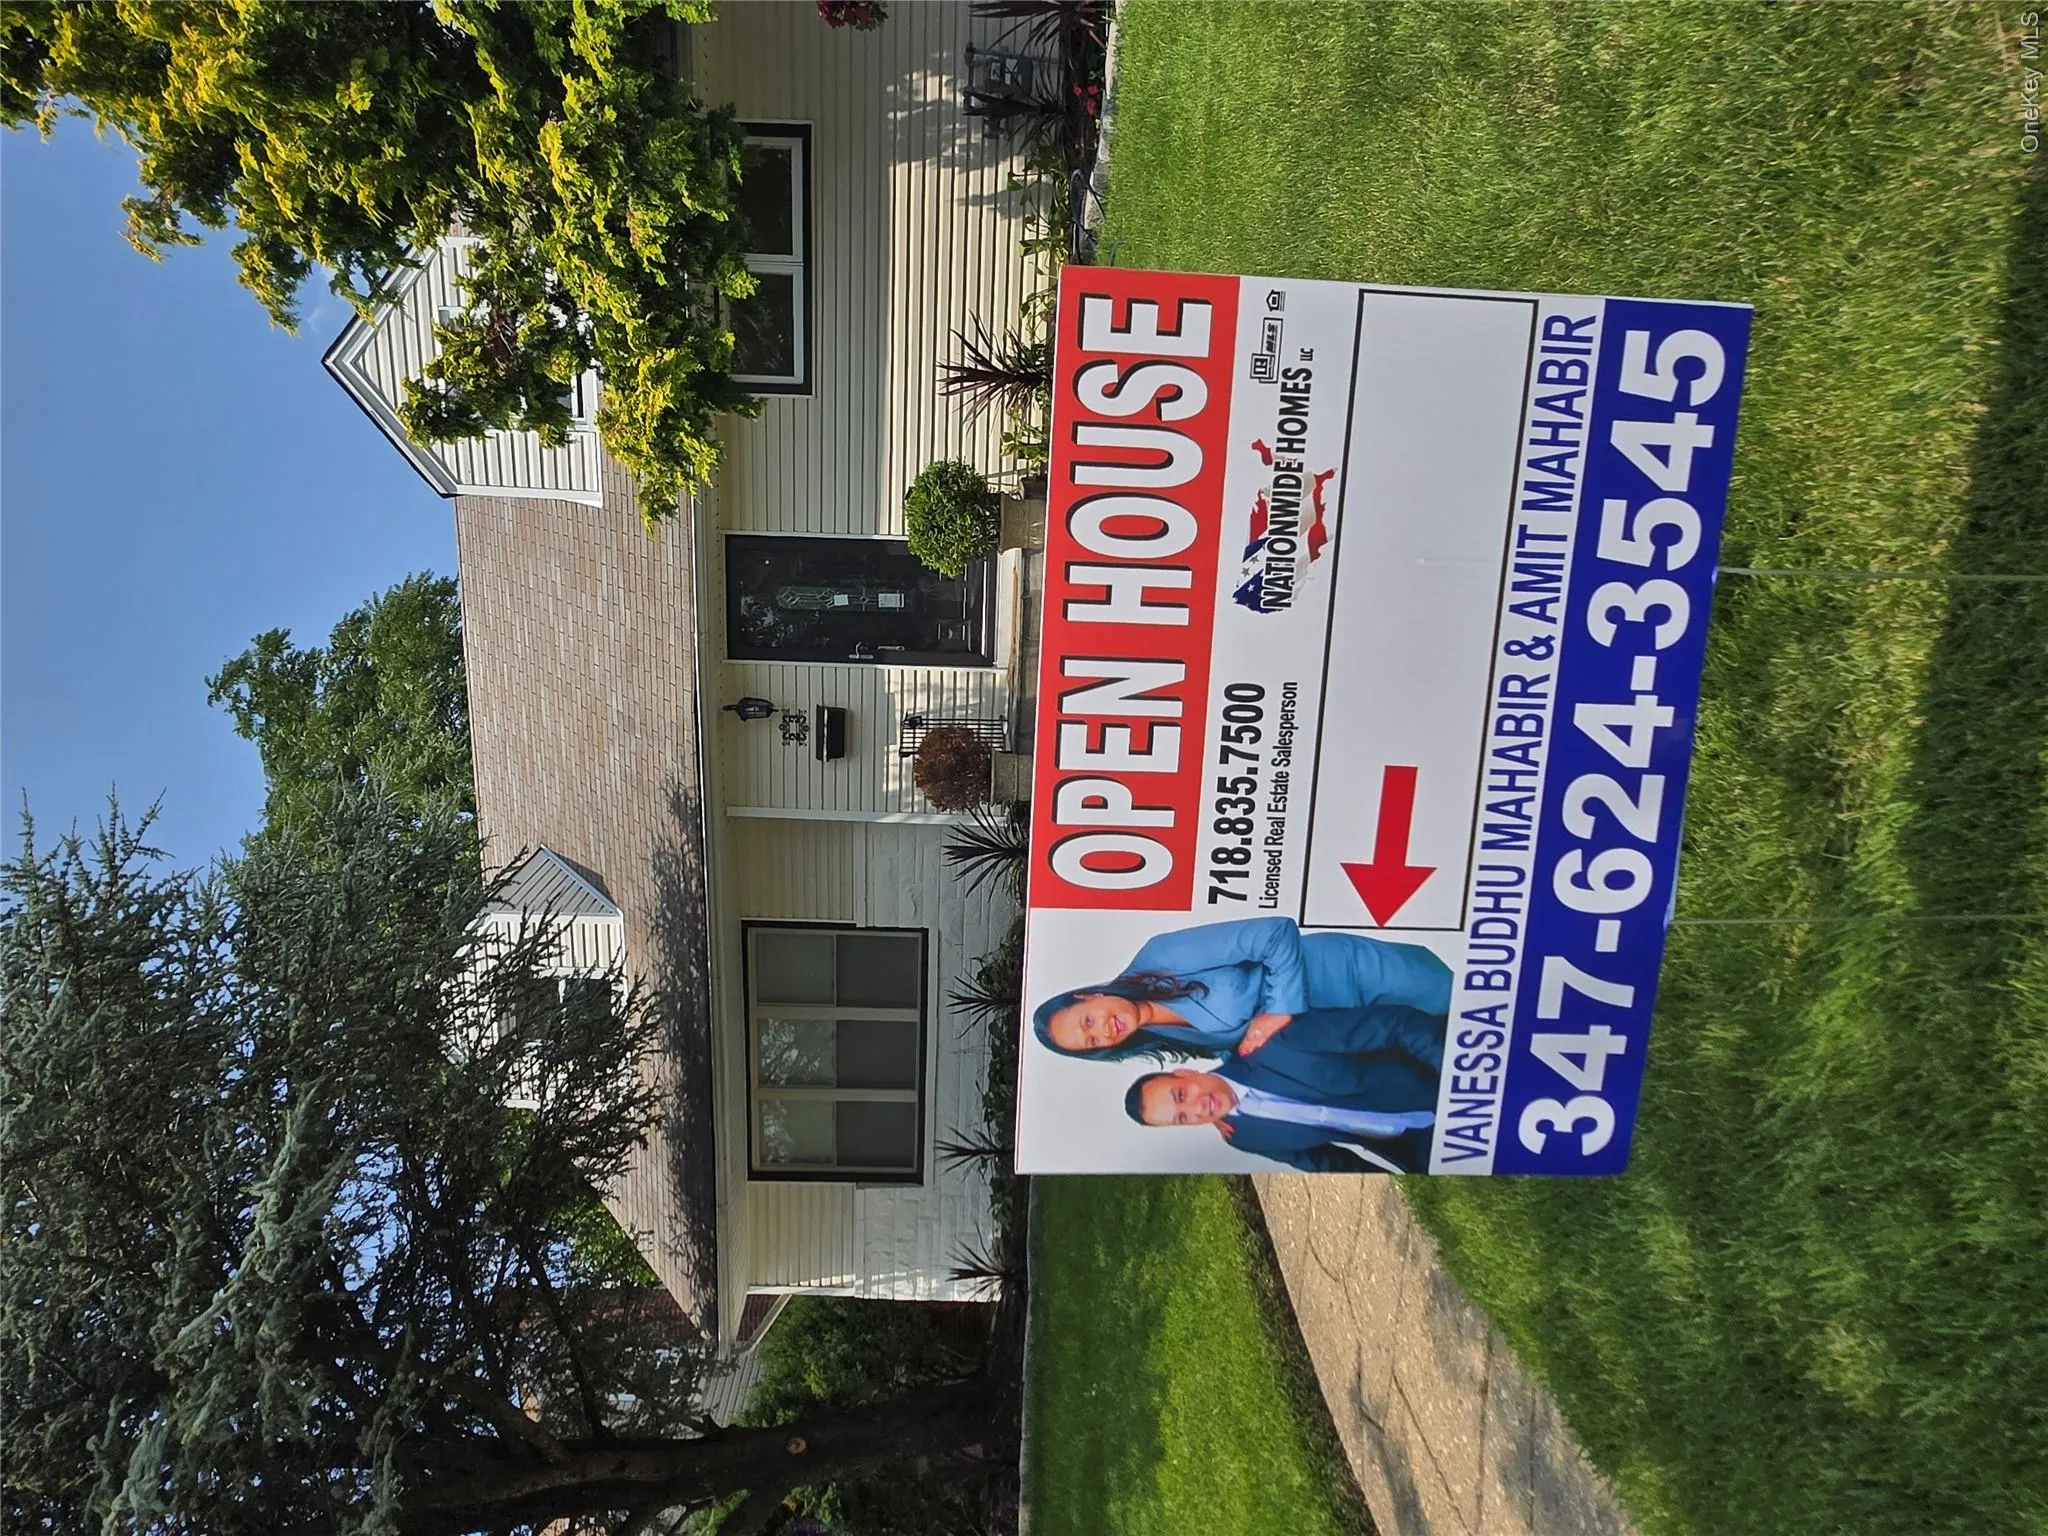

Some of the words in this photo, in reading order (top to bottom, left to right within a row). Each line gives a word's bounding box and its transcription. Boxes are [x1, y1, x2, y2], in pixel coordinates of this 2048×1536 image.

[1265, 323, 1276, 353] MLS
[1300, 348, 1313, 361] LLC
[1064, 292, 1213, 626] HOUSE
[1275, 367, 1313, 453] HOMES
[1521, 314, 1597, 511] MAHABIR
[1261, 460, 1304, 608] NATIONWIDE
[1509, 524, 1569, 624] AMIT
[1503, 633, 1555, 661] &
[1048, 655, 1186, 890] OPEN
[1271, 681, 1299, 767] Salesperson
[1481, 675, 1551, 851] MAHABIR
[1517, 327, 1727, 1157] 347-624-3545
[1207, 682, 1266, 905] 718.835.7500
[1264, 816, 1286, 846] Real
[1267, 770, 1290, 813] Estate
[1258, 849, 1283, 909] Licensed
[1464, 864, 1526, 991] BUDHU
[1440, 1003, 1510, 1163] VANESSA
